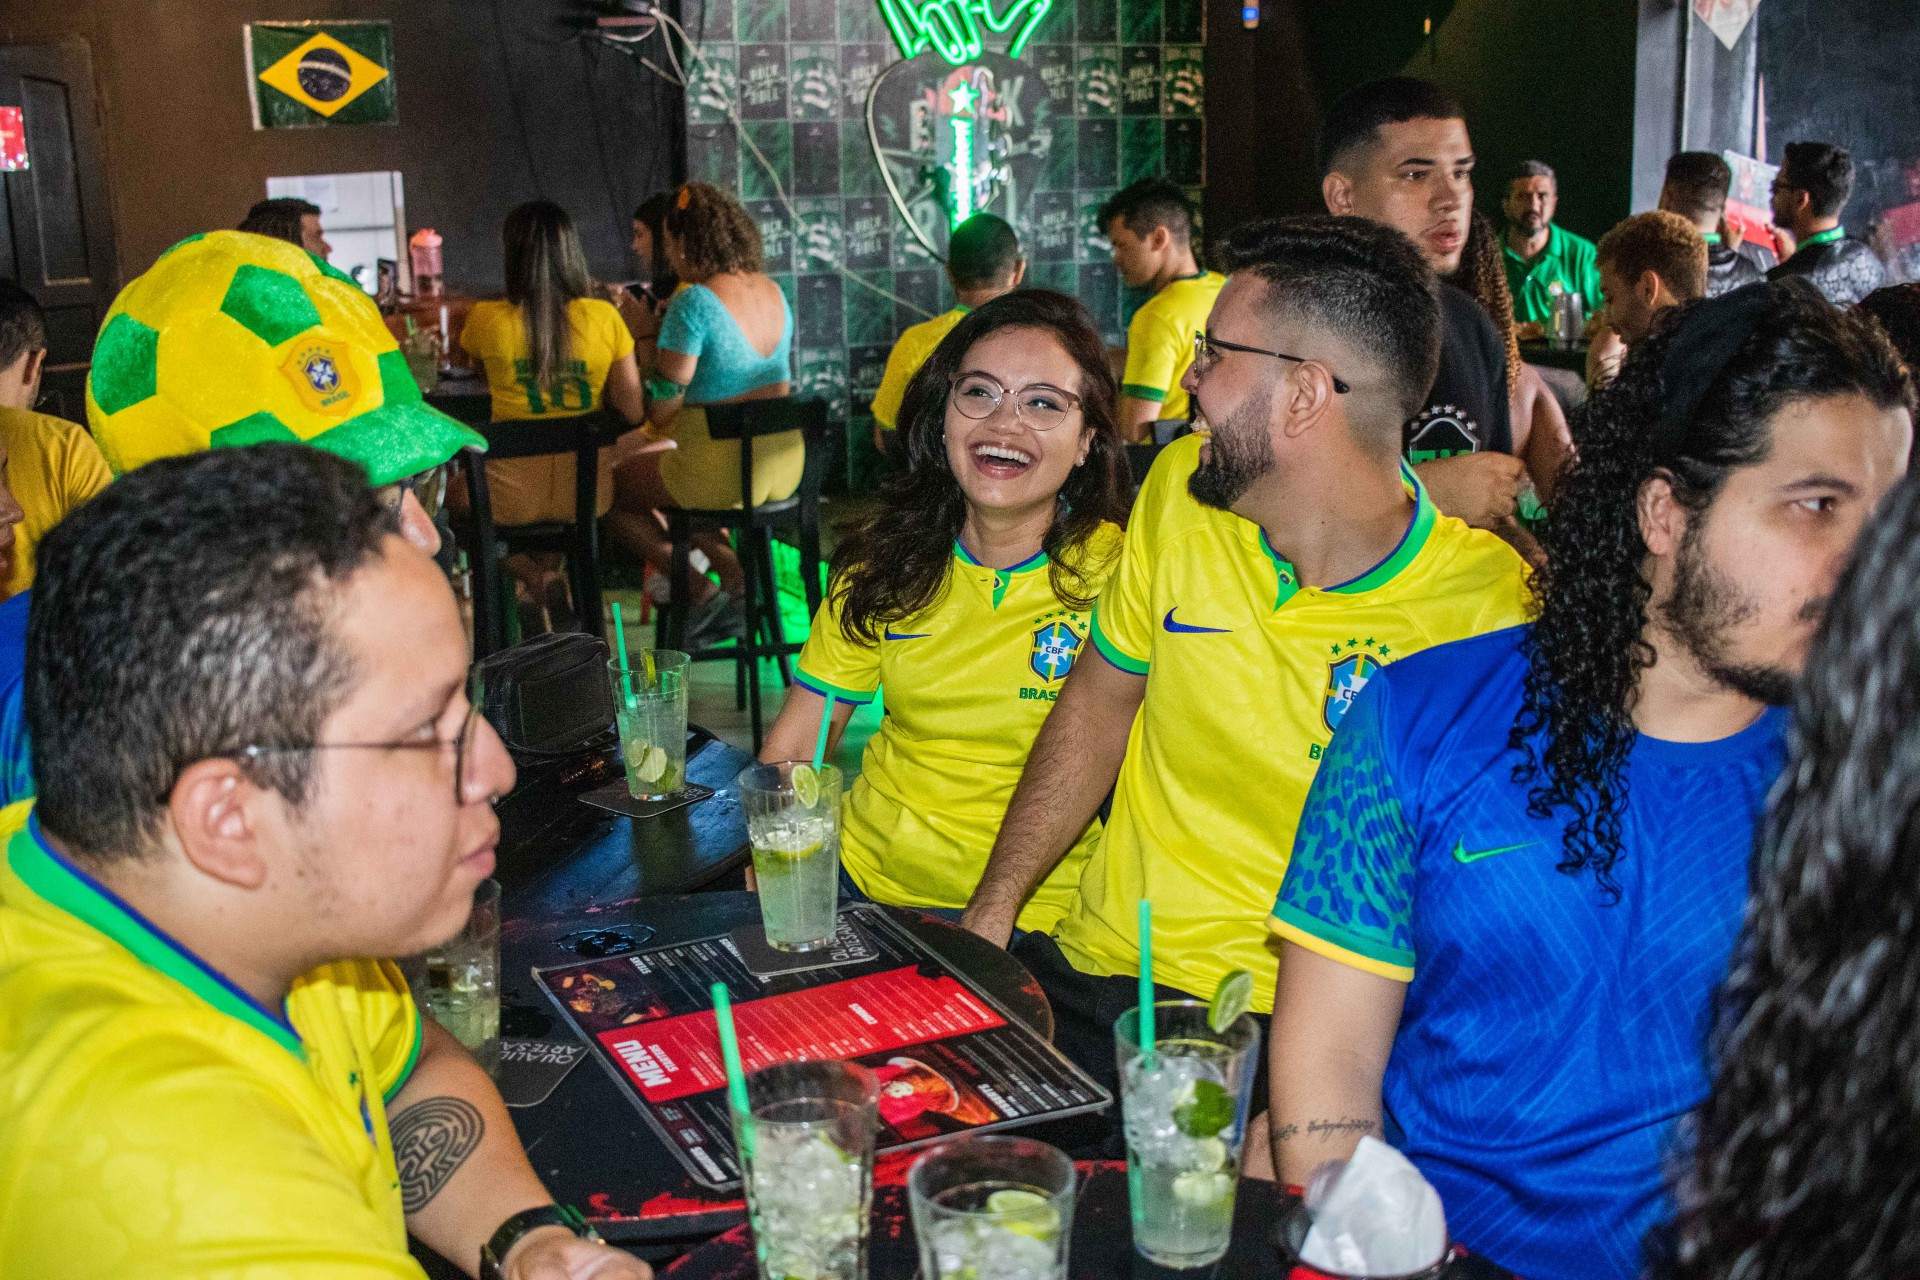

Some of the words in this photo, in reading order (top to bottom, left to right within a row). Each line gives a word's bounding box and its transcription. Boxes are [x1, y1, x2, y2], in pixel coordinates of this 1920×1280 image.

[1045, 646, 1064, 655] CBF
[1018, 687, 1058, 701] BRAS
[610, 1038, 674, 1087] MENU
[646, 1042, 681, 1072] STARTERS
